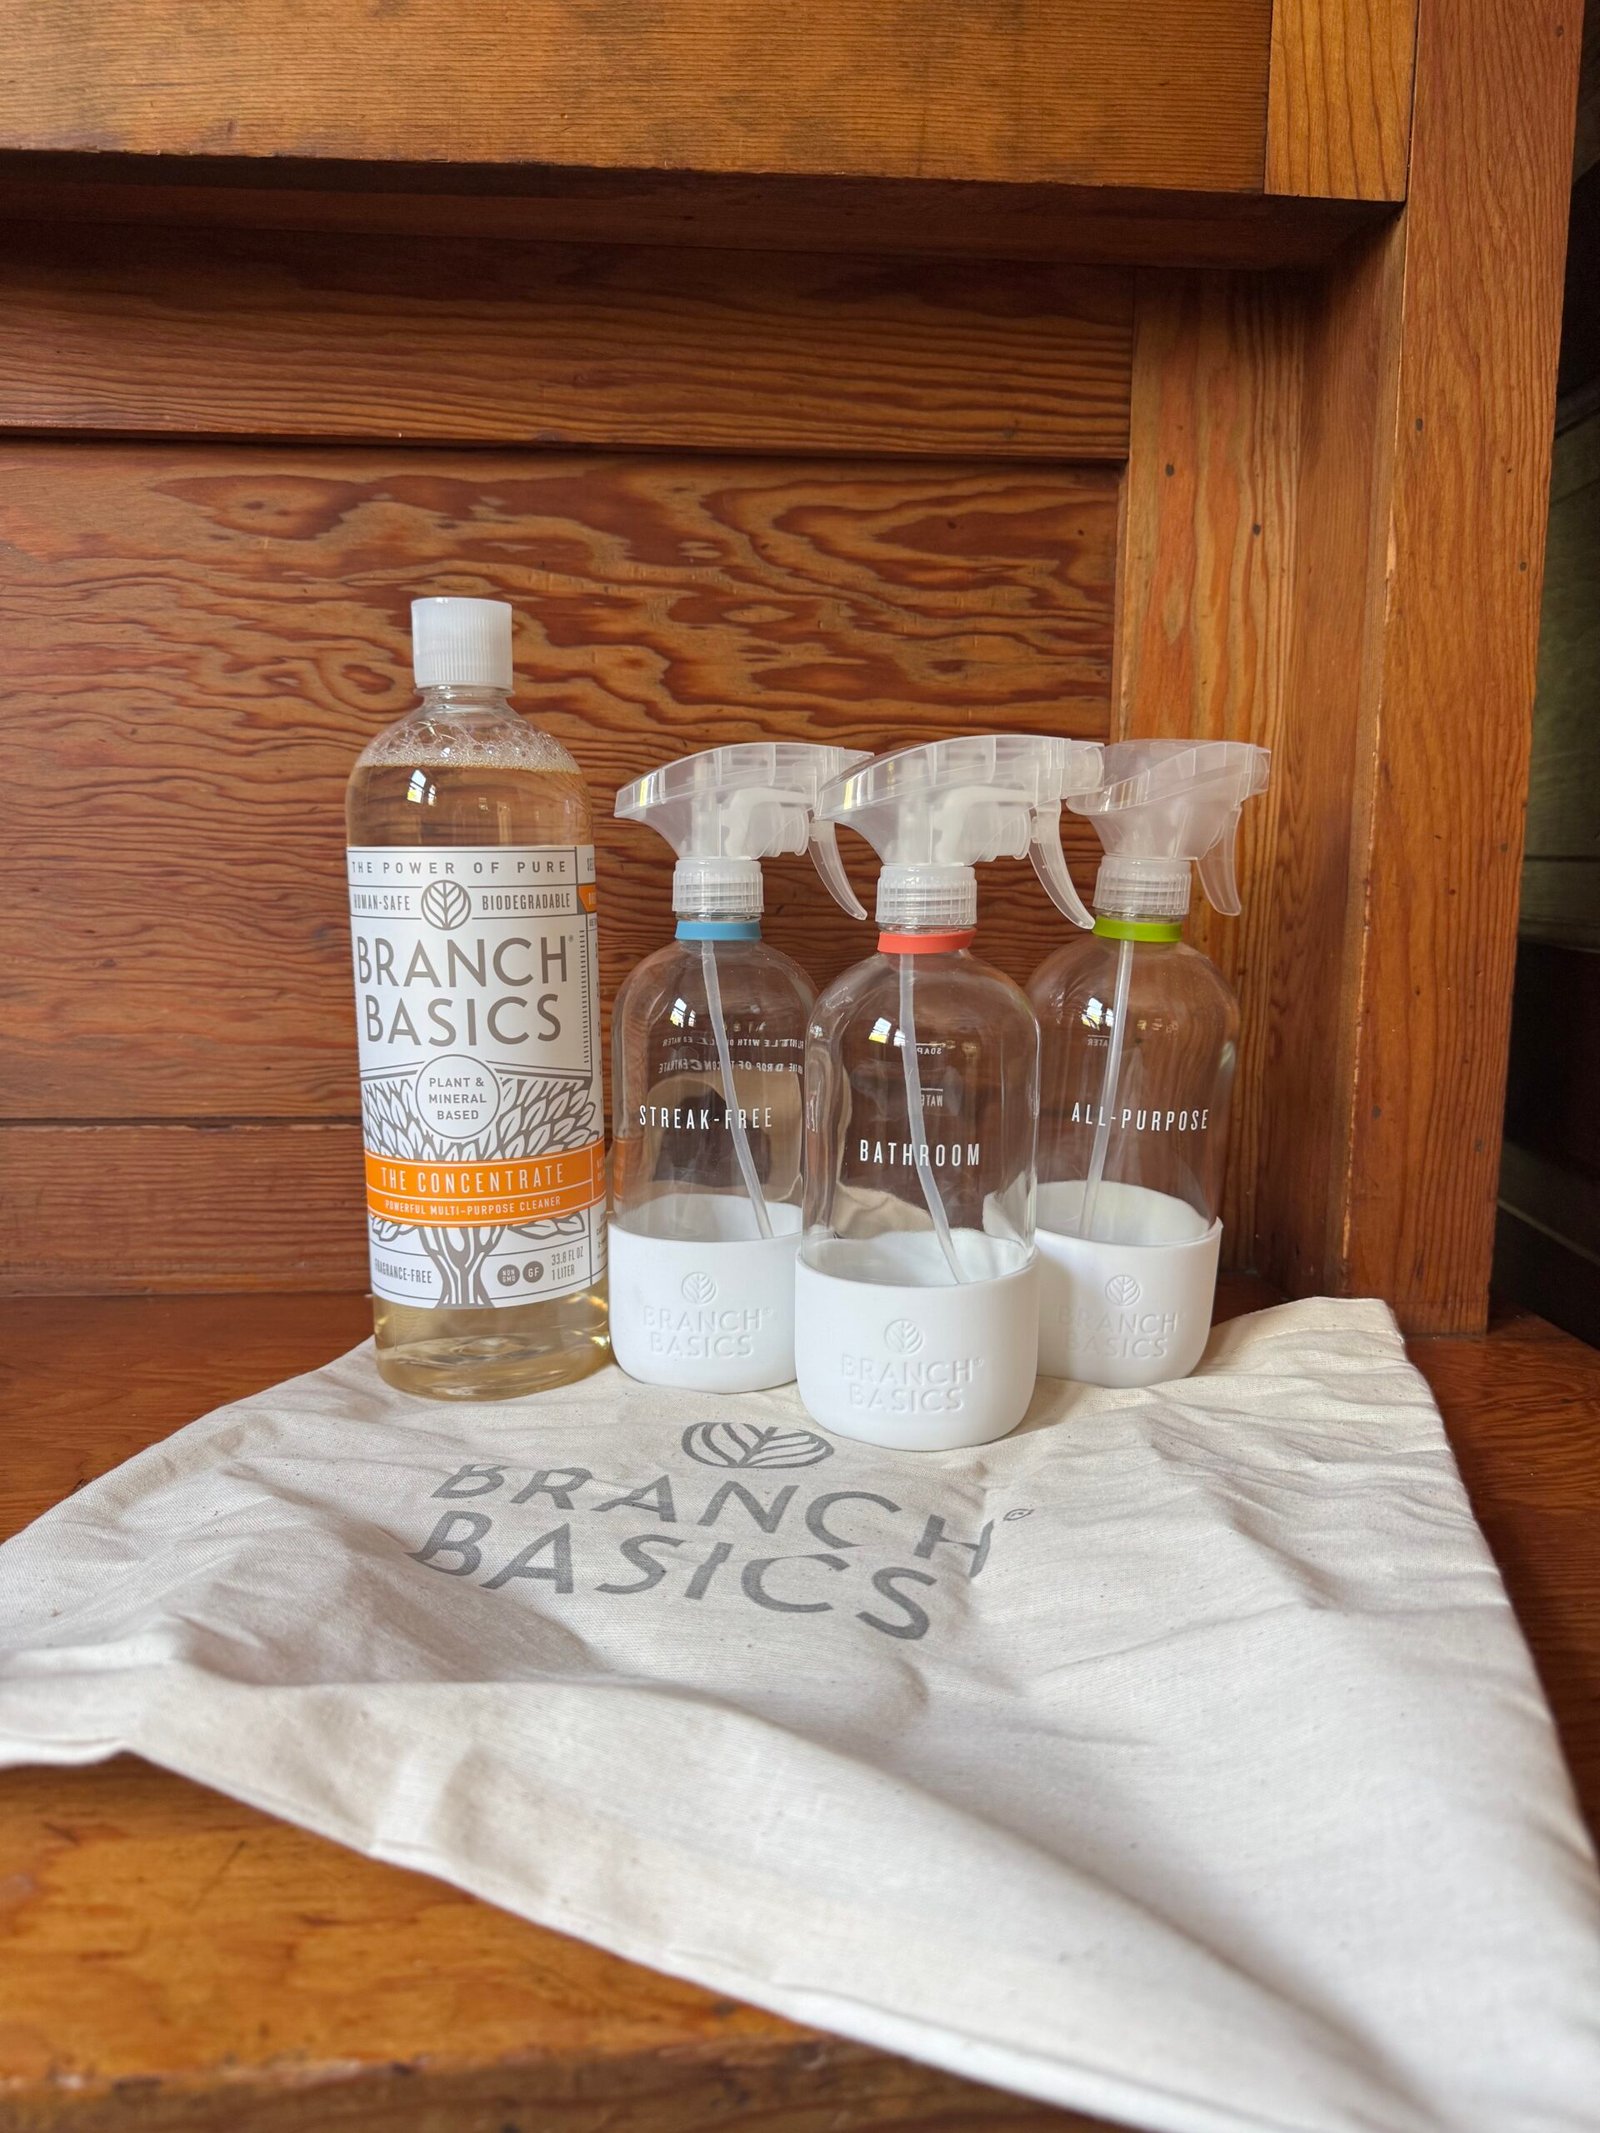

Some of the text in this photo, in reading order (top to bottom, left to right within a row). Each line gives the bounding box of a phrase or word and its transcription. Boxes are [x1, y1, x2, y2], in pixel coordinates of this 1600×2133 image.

[352, 860, 566, 875] THE POWER OF PURE
[482, 892, 571, 911] BIODEGRADABLE
[357, 935, 568, 988] BRANCH
[365, 994, 561, 1046] BASICS
[429, 1077, 485, 1088] PLANT &
[428, 1093, 487, 1104] MINERAL
[437, 1110, 479, 1121] BASED
[639, 1105, 772, 1130] STREAK-FREE
[1071, 1102, 1209, 1131] ALL-PURPOSE
[859, 1139, 980, 1167] BATHROOM
[380, 1166, 407, 1191] THE
[417, 1162, 564, 1194] CONCENTRATE
[384, 1195, 561, 1216] POWERFUL MULTI-PURPOSE CLEANER
[528, 1266, 540, 1277] GF
[551, 1252, 567, 1266] 33.8
[568, 1250, 575, 1262] FL
[557, 1264, 575, 1280] LITER
[643, 1305, 762, 1333] BRANCH
[650, 1332, 754, 1359] BASICS
[841, 1352, 973, 1386] BRANCH
[850, 1384, 964, 1414] BASICS
[431, 1464, 994, 1577] BRANCH
[406, 1510, 937, 1640] BASICS
